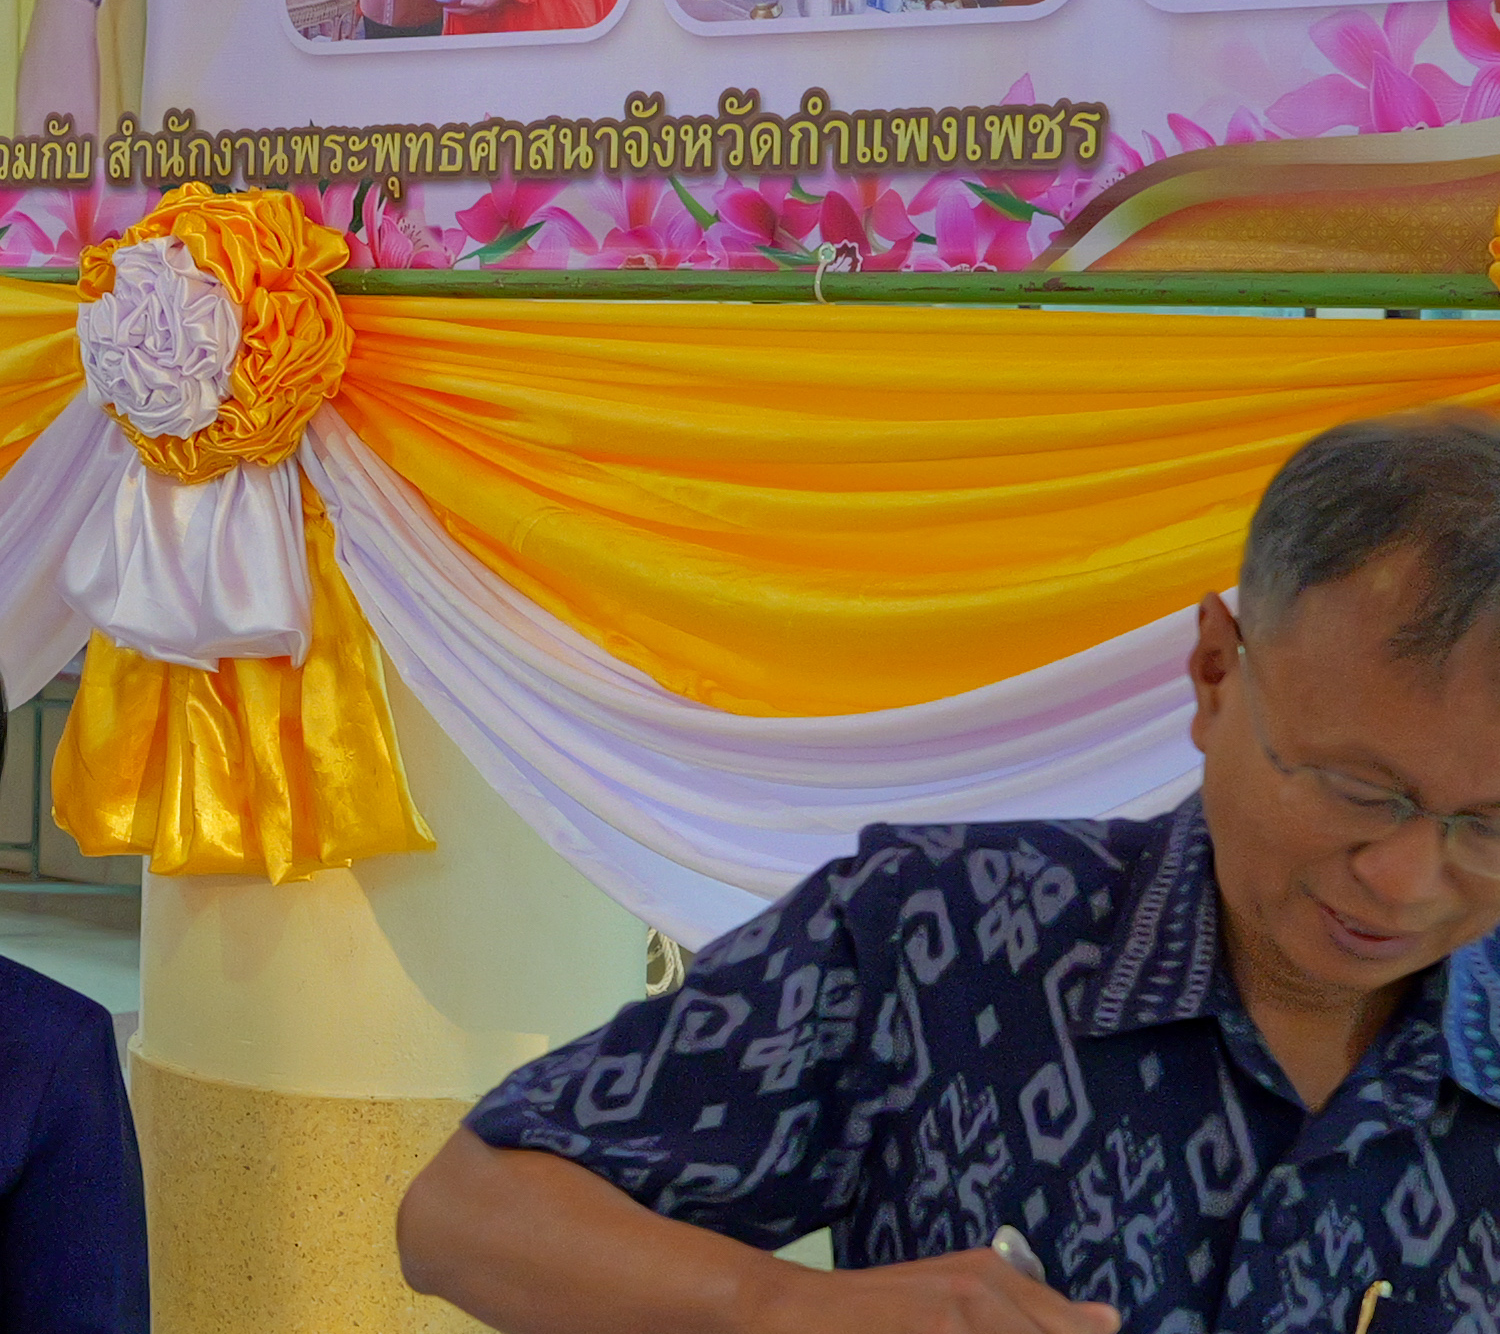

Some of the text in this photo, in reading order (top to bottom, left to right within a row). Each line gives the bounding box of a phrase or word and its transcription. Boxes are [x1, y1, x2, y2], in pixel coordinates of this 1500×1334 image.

[107, 95, 1103, 200] สำนักงานพระพุทธศาสนาจังหวัดกำแพงเพชร
